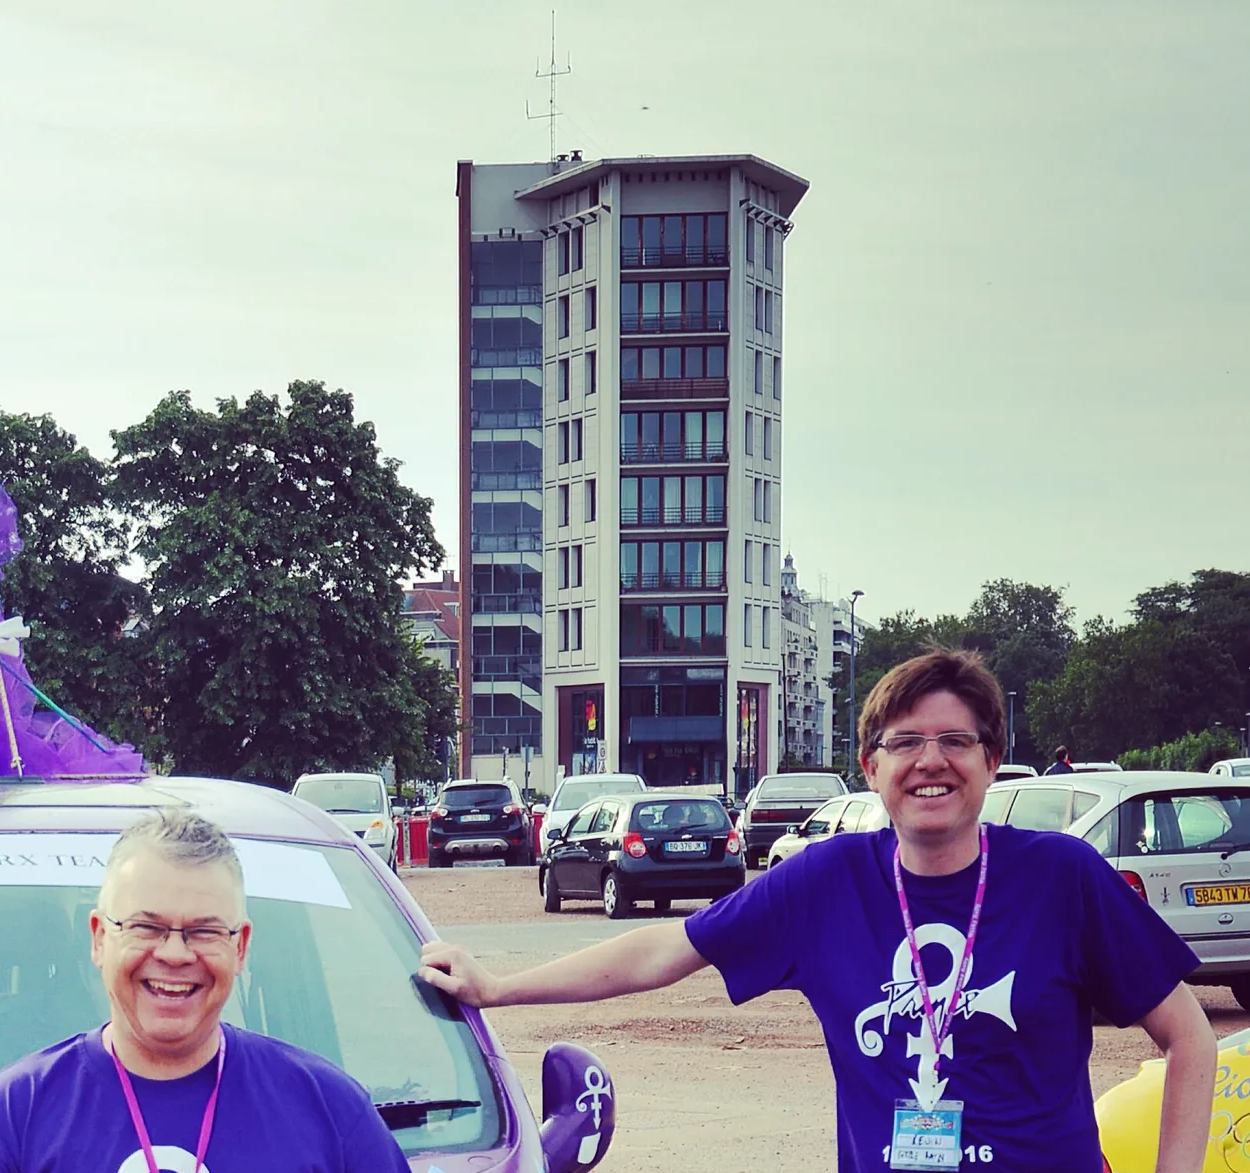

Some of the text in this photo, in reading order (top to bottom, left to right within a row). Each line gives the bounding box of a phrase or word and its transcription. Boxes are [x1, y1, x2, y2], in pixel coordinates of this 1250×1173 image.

[48, 854, 108, 868] TEA
[1195, 888, 1223, 903] 5843
[1224, 888, 1237, 902] TW
